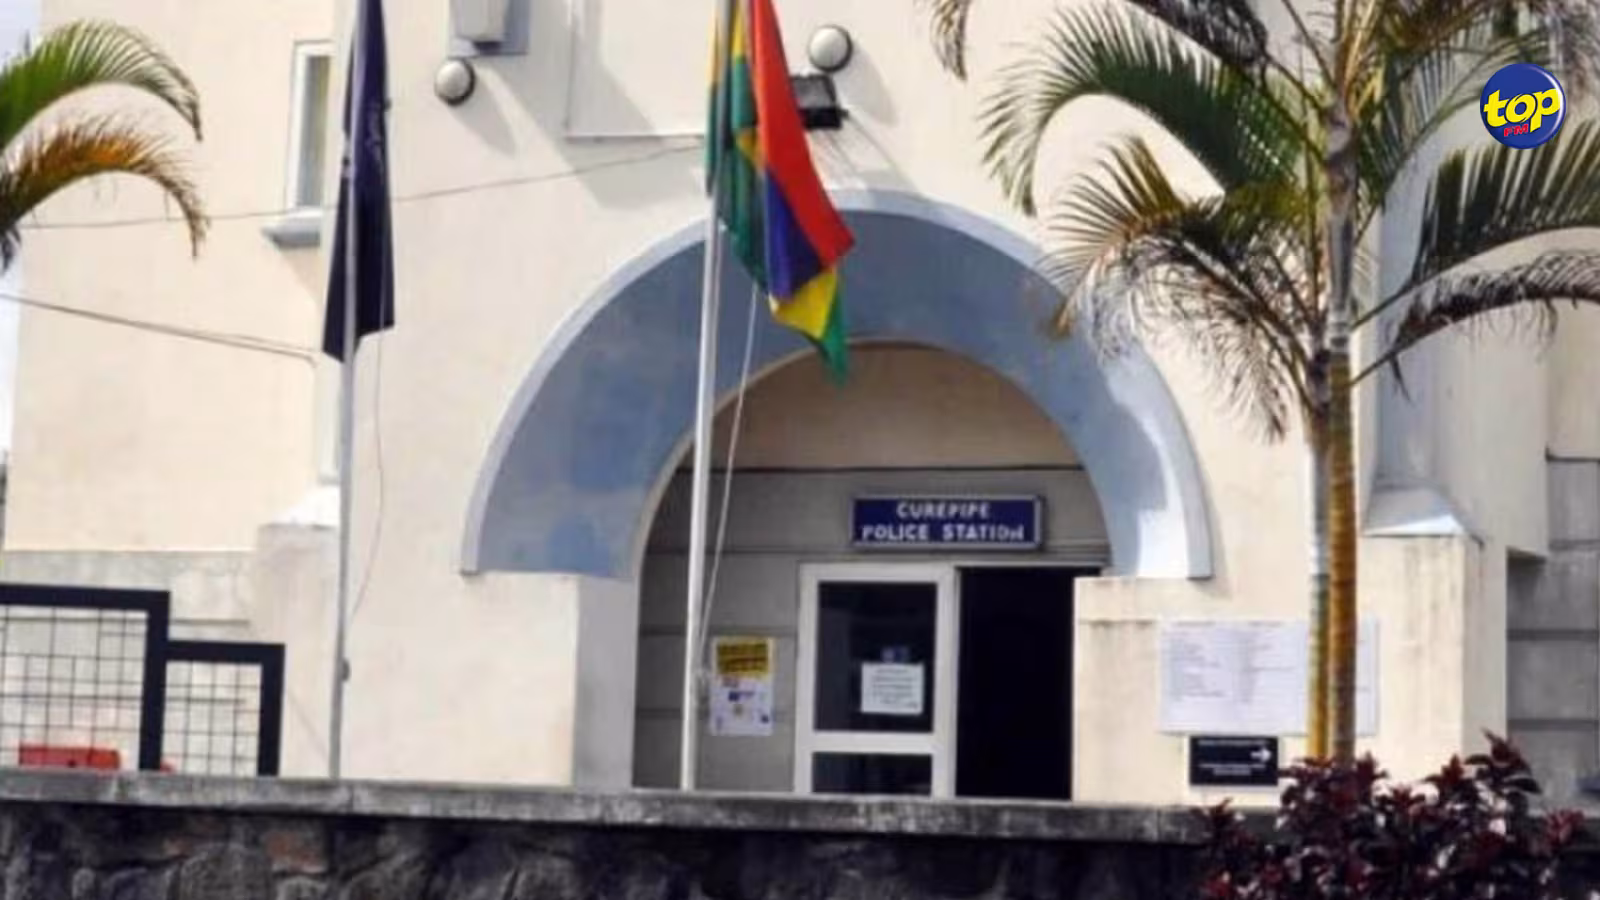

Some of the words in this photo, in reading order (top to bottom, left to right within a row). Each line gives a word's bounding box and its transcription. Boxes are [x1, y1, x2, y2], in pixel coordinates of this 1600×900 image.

[896, 501, 990, 519] CUREPIPE
[862, 523, 929, 541] POLICE
[942, 523, 1025, 541] STATION
